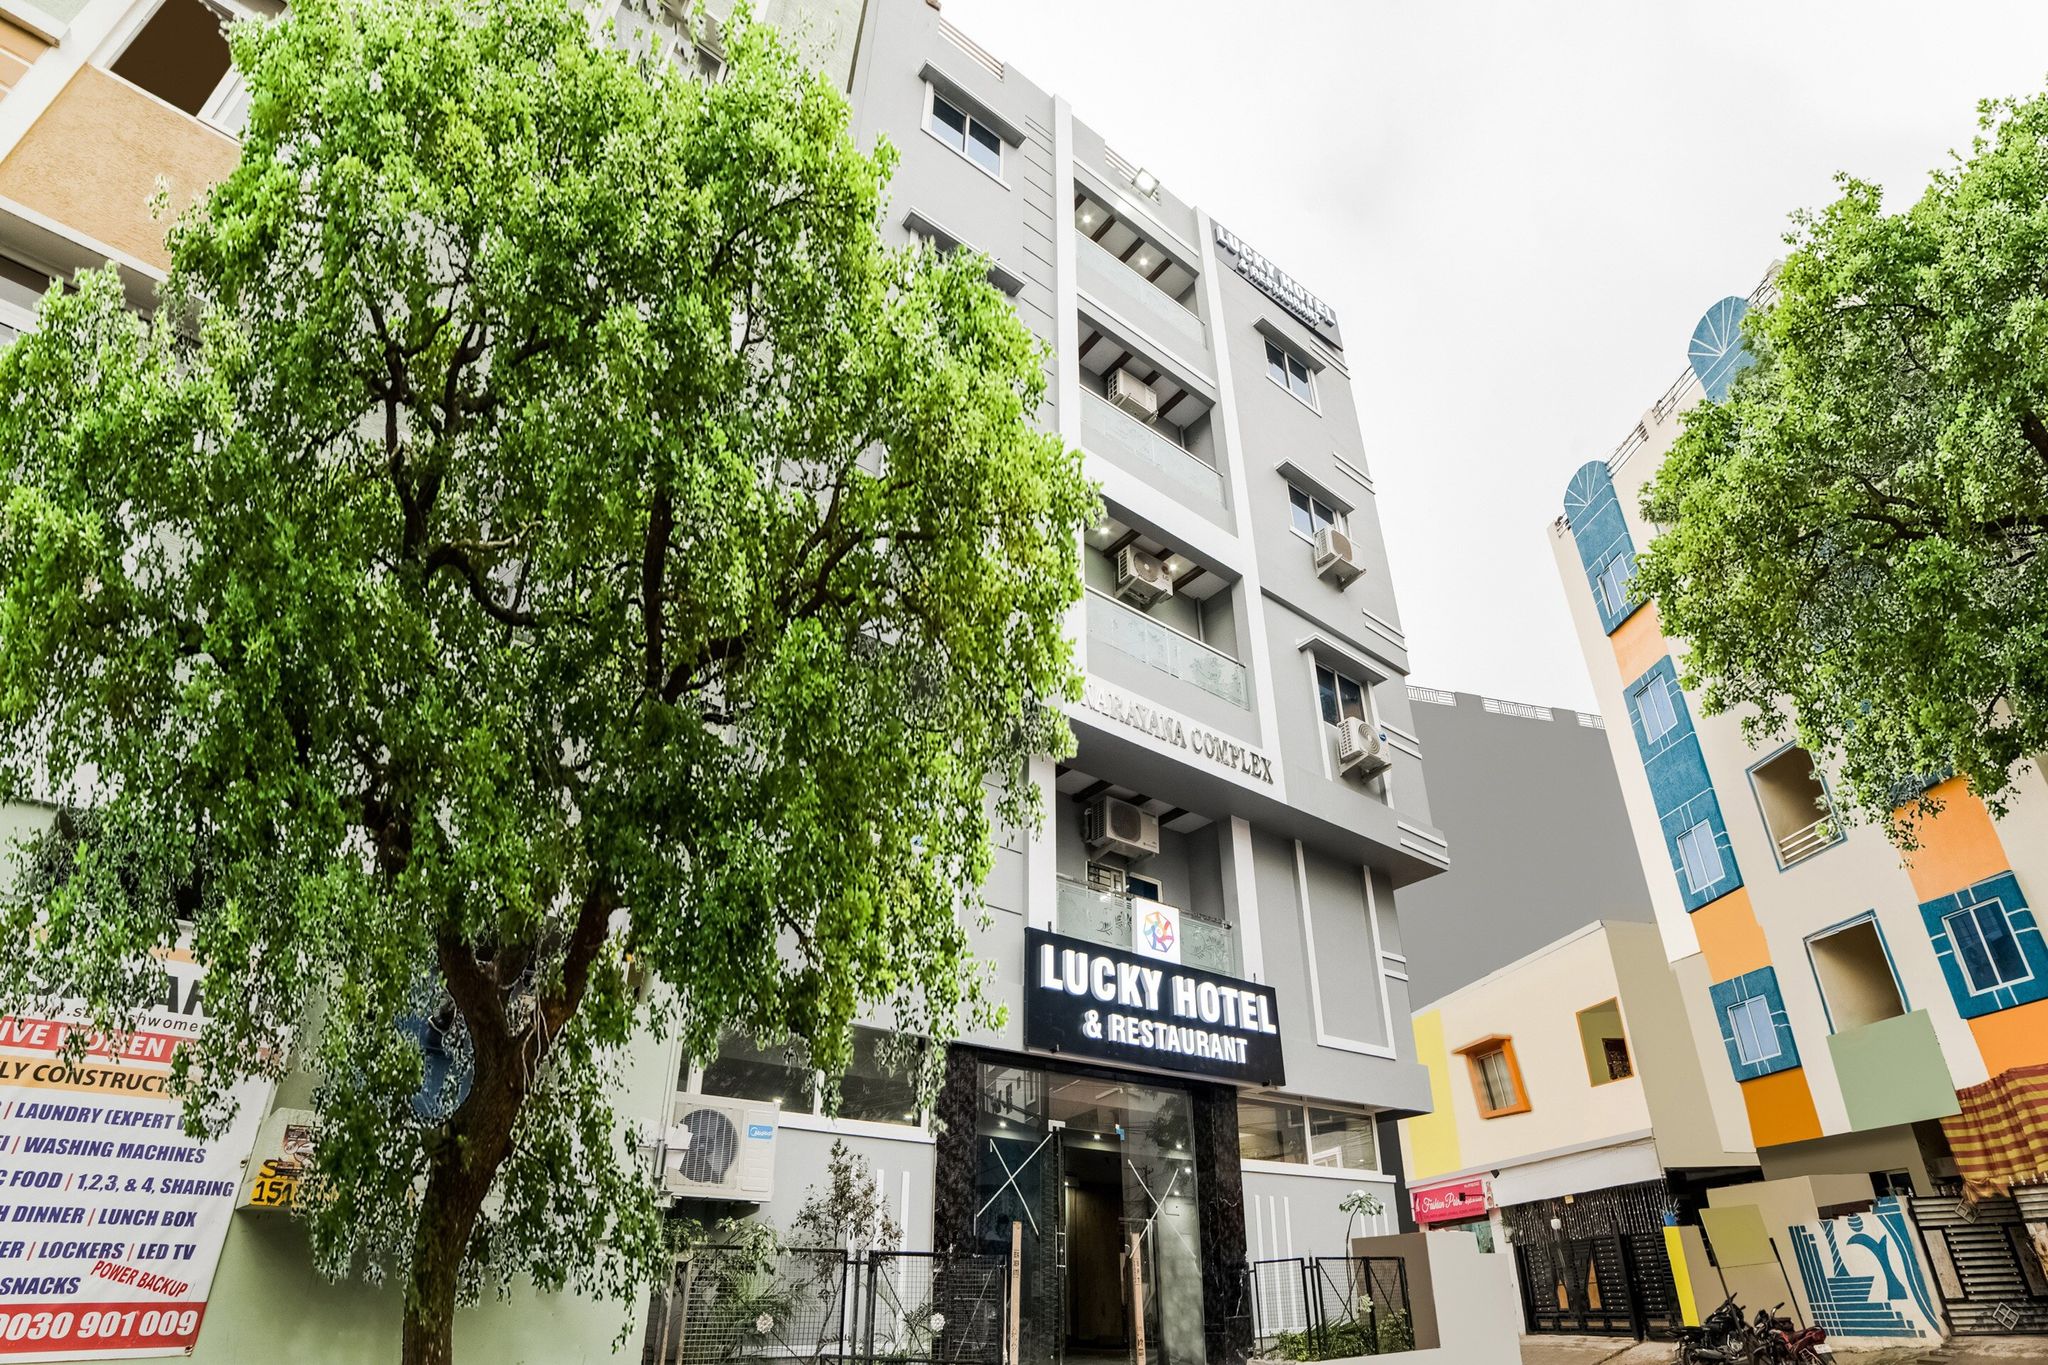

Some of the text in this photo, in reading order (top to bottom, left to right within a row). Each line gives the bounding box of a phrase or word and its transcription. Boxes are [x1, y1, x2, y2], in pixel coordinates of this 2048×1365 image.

[1215, 224, 1336, 328] LUCKY HOTEL
[1190, 726, 1275, 786] COMPLEX
[1040, 943, 1277, 1035] LUCKY HOTEL
[1082, 1008, 1248, 1065] & RESTAURANT
[15, 1102, 103, 1124] LAUNDRY
[104, 1109, 175, 1130] (EXPERT
[24, 1136, 114, 1158] WASHING
[116, 1142, 206, 1164] MACHINES
[9, 1170, 63, 1189] FOOD
[124, 1178, 137, 1193] &
[160, 1178, 234, 1197] SHARING
[11, 1205, 86, 1224] DINNER
[98, 1208, 160, 1226] LUNCH
[161, 1210, 198, 1228] BOX
[38, 1241, 125, 1260] LOCKERS
[137, 1243, 169, 1260] LED
[172, 1244, 197, 1260] TV
[0, 1276, 81, 1296] SNACKS
[90, 1260, 189, 1298] POWER BACKUP
[77, 1311, 141, 1338] 901
[138, 1310, 199, 1337] 009
